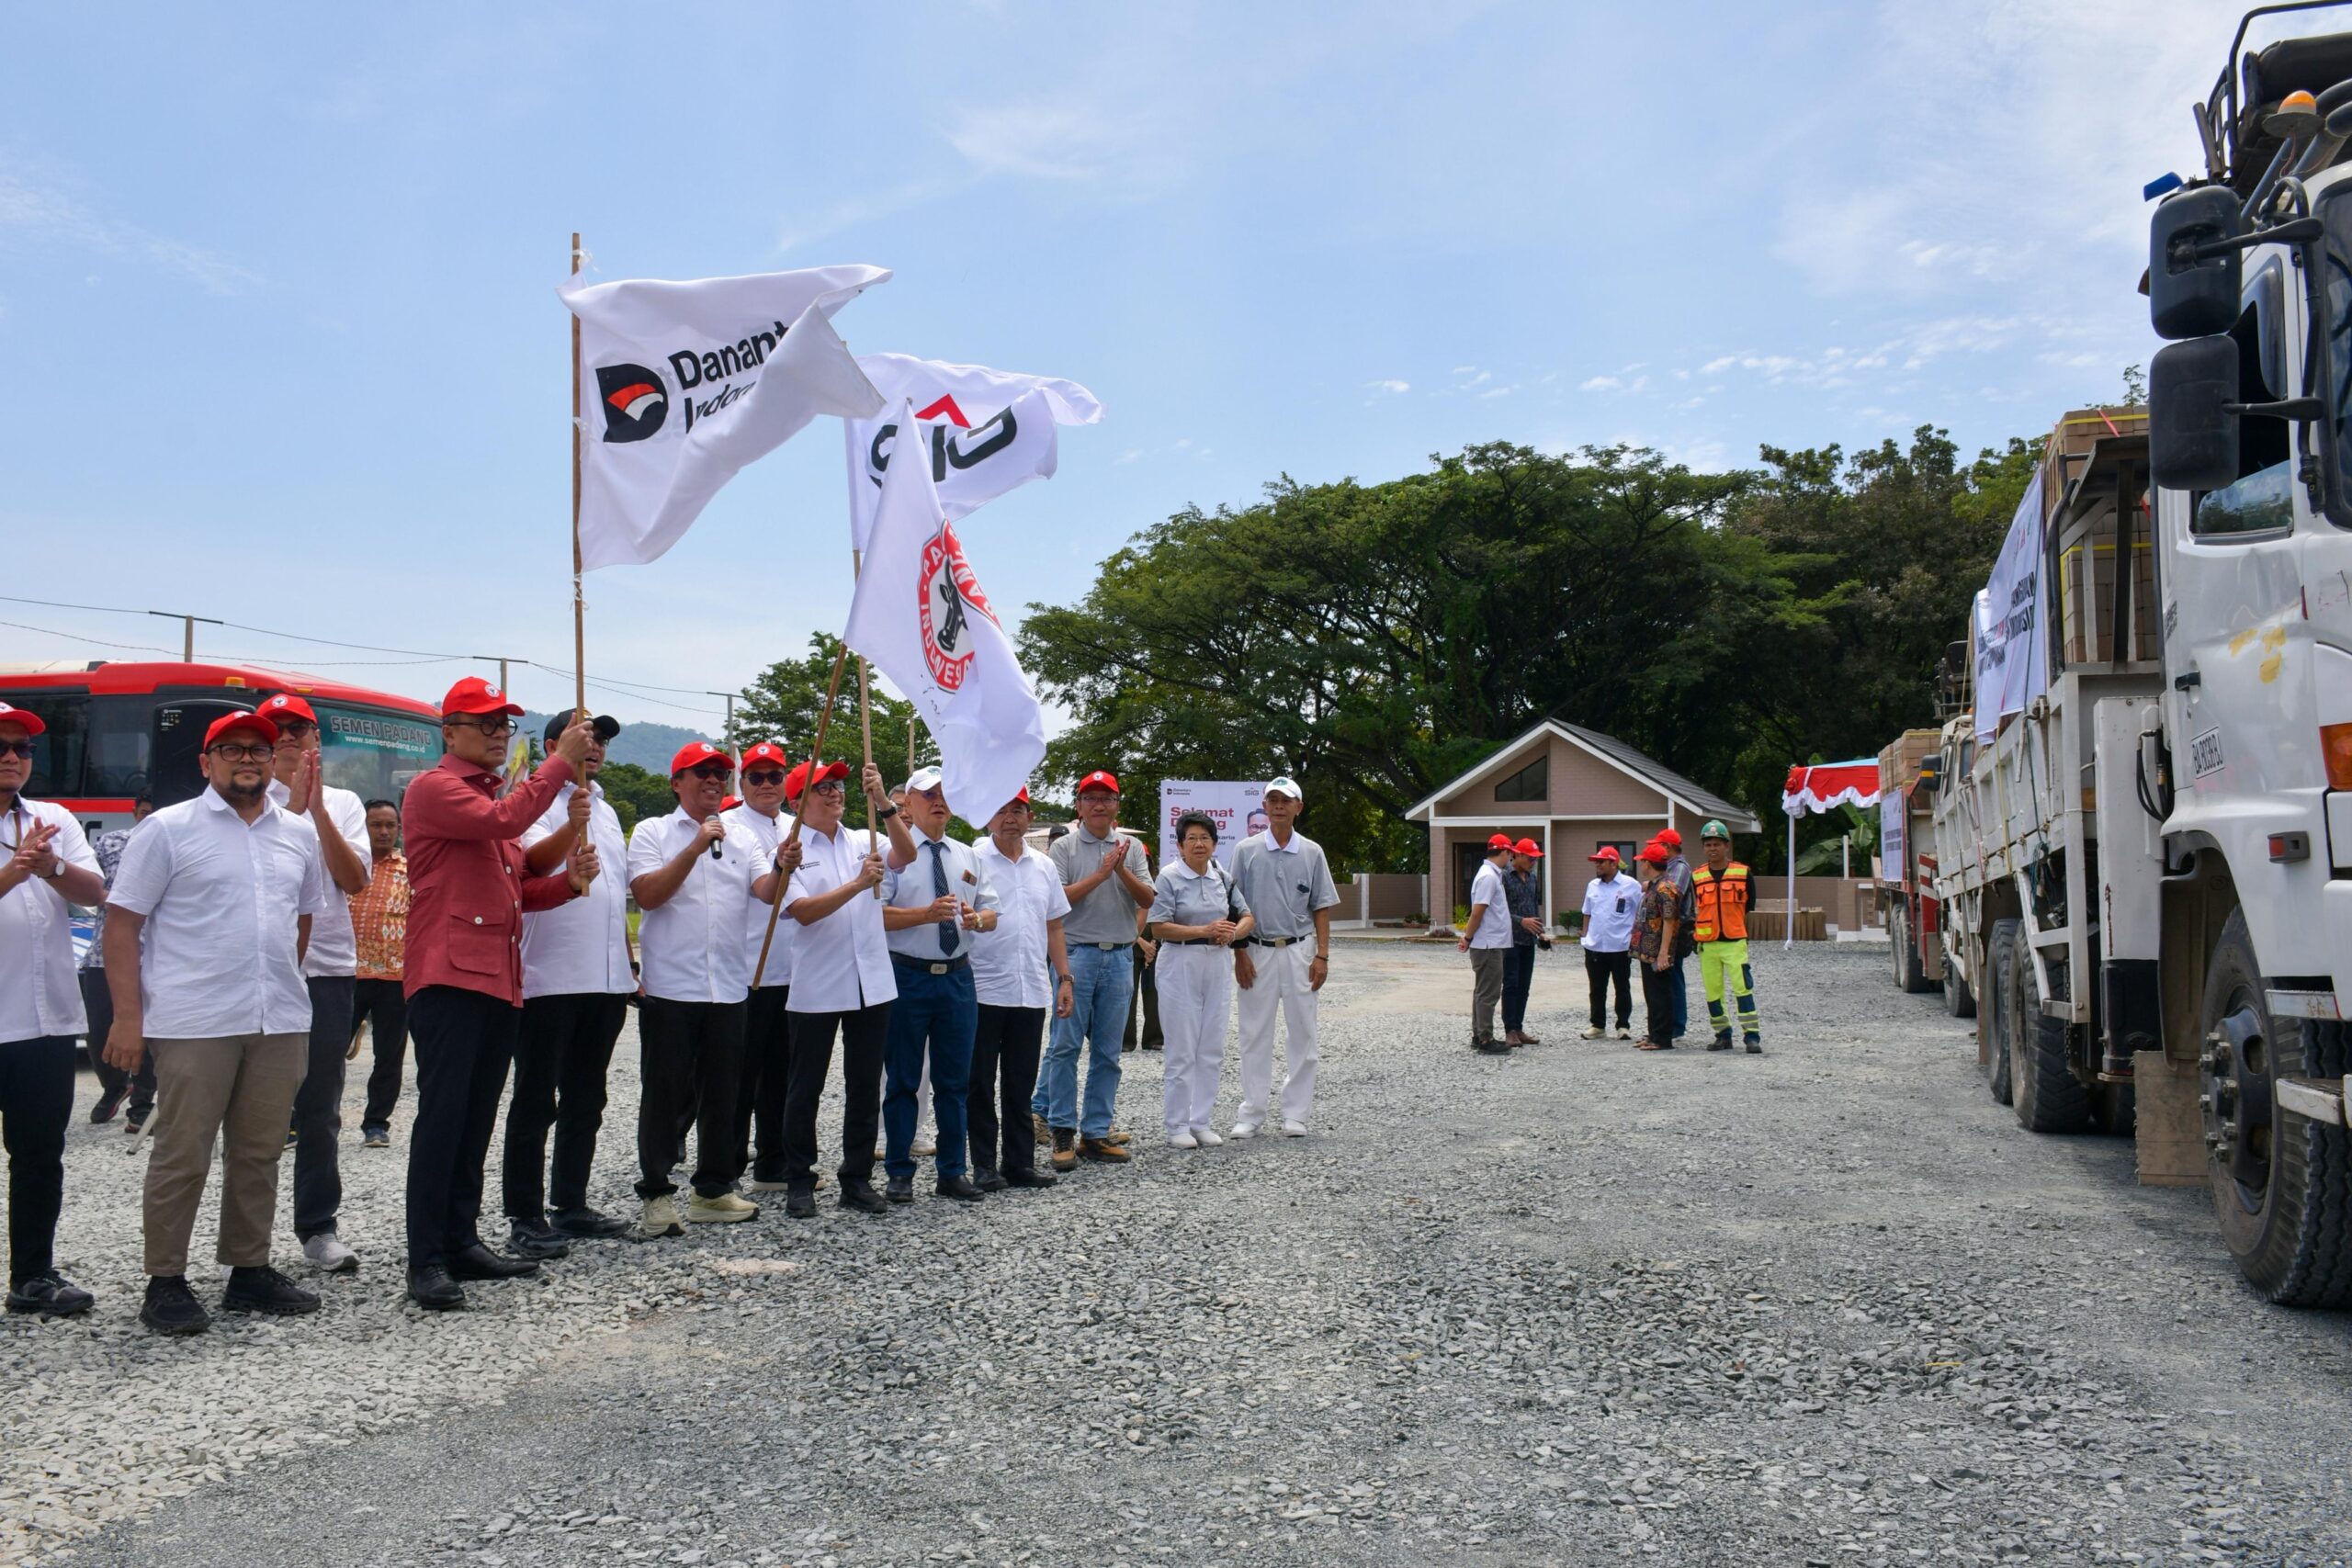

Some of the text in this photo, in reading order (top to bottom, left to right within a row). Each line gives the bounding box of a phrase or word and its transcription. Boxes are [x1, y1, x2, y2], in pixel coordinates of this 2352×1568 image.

[668, 321, 789, 390] Danant
[684, 381, 757, 434] Indon
[331, 716, 432, 745] SEMEN PADANG
[345, 736, 425, 752] www.semenpadang.co.id
